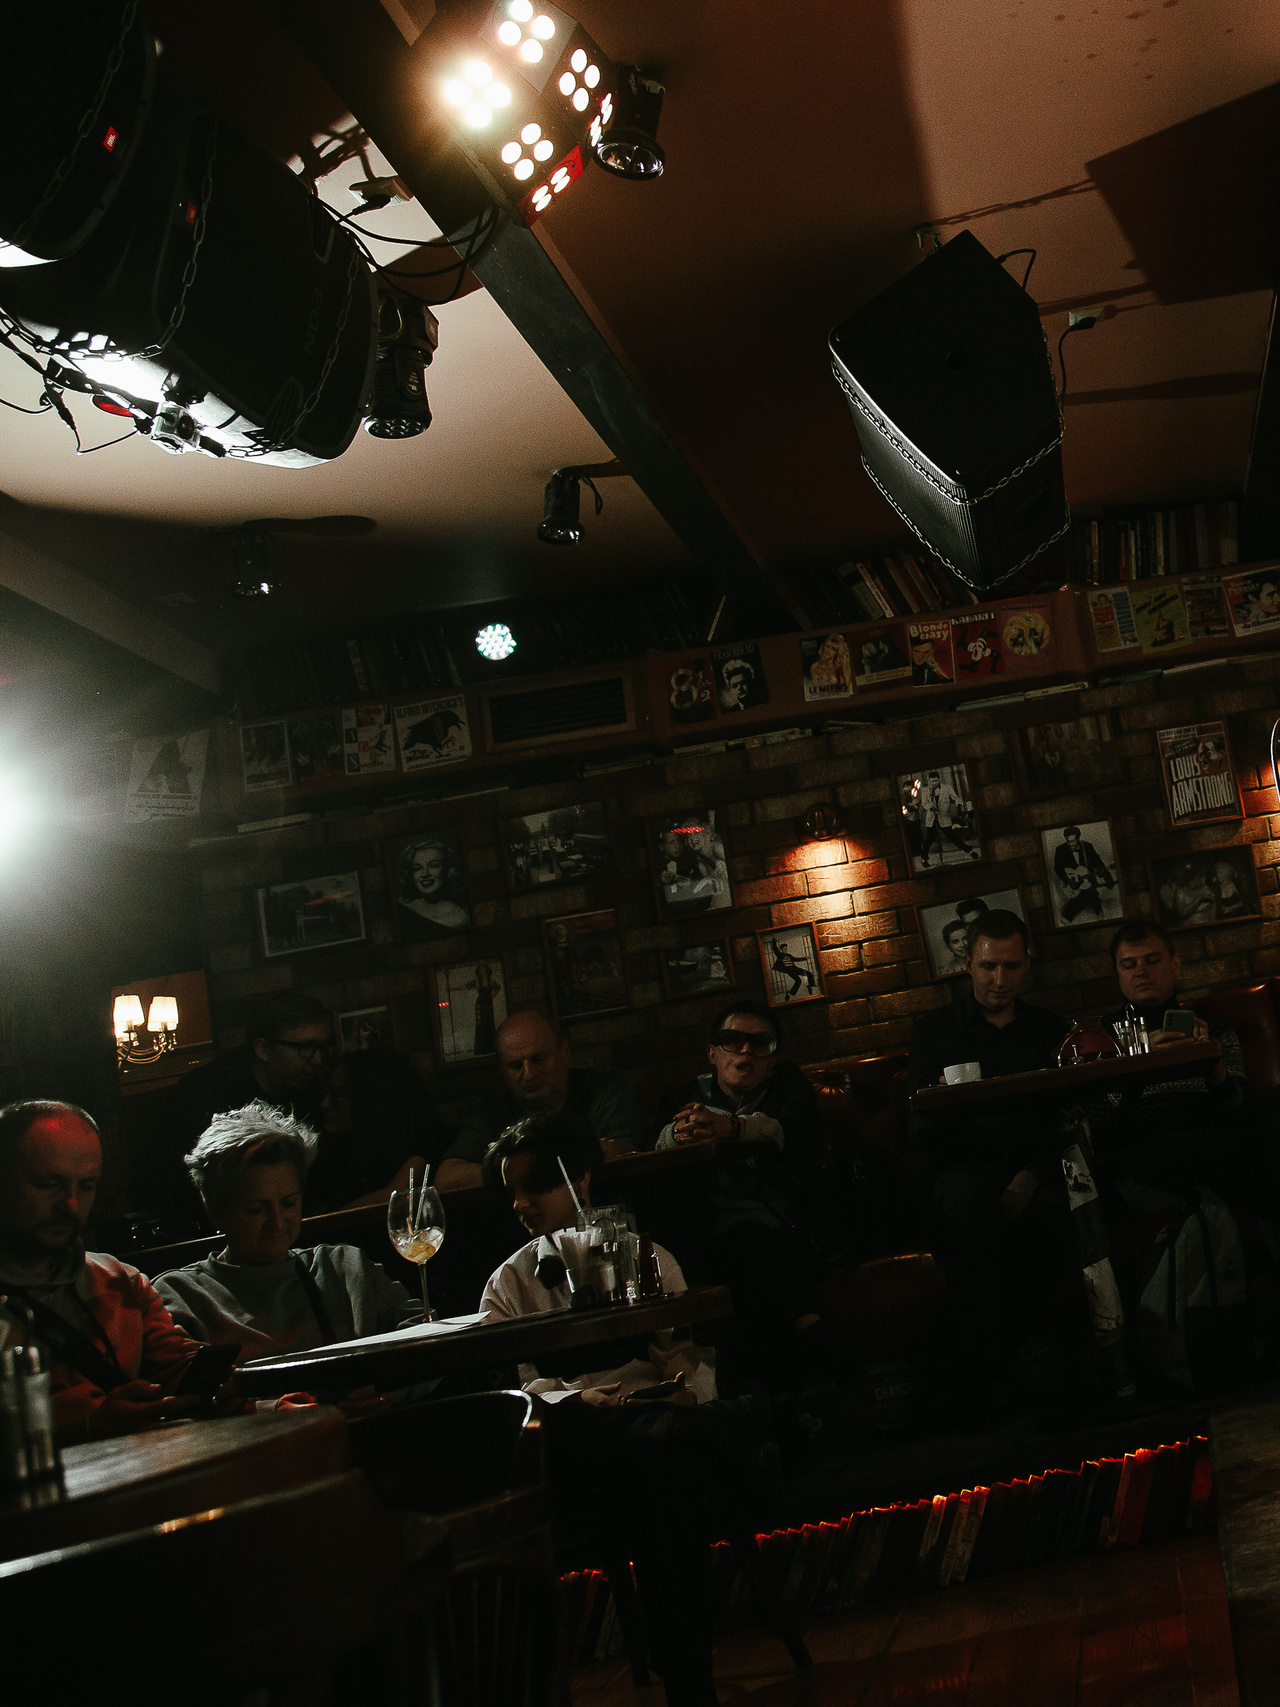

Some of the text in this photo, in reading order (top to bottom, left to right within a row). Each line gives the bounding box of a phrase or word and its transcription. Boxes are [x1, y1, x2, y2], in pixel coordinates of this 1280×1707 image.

[909, 622, 949, 638] Blonde
[1242, 617, 1280, 630] Jailhouse
[920, 630, 950, 641] crazy
[713, 644, 755, 660] ERASERHEAD
[1169, 753, 1201, 783] LOUIS
[1172, 771, 1235, 818] ARMSTRONG
